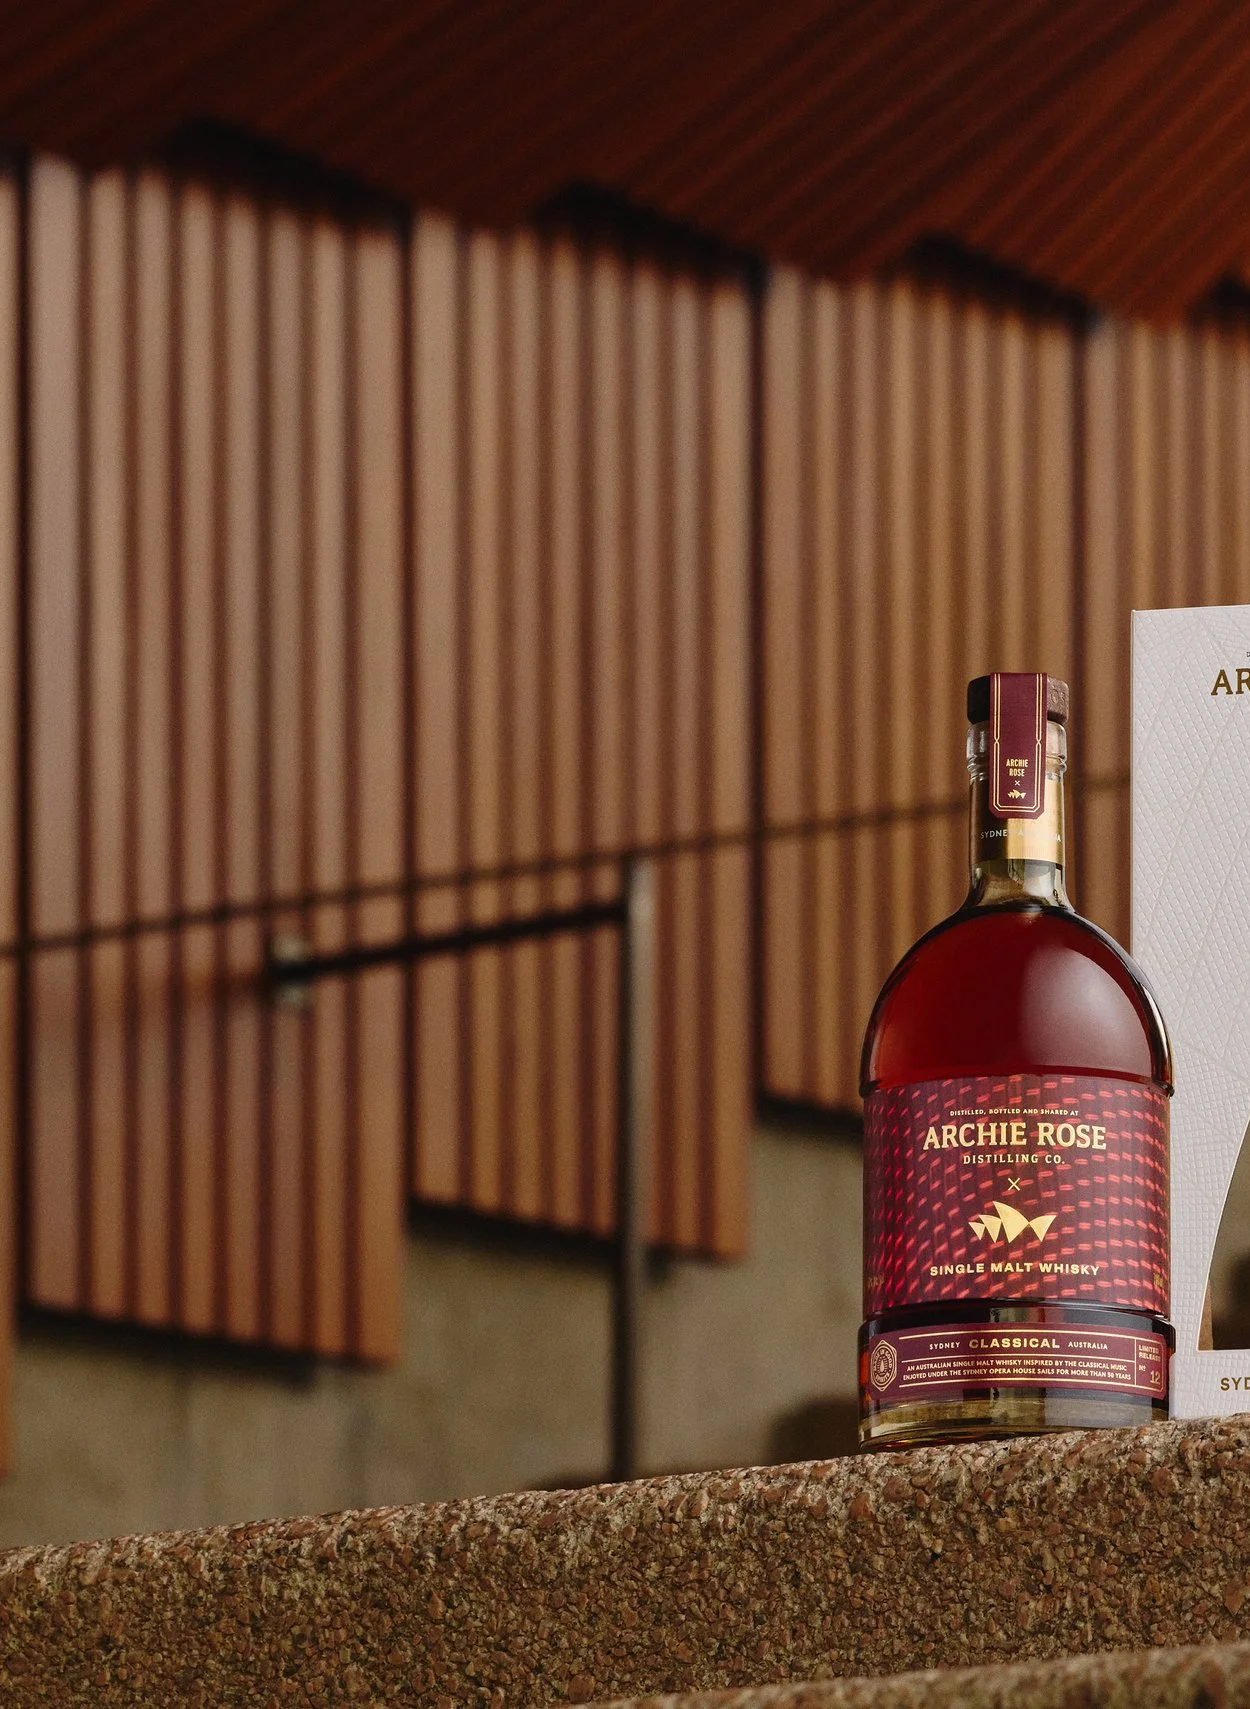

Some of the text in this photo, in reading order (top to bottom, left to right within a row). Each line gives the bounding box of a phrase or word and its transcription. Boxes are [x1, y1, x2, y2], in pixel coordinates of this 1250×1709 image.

[1006, 758, 1029, 768] ARCHIE
[1008, 768, 1026, 777] ROSE
[980, 829, 1008, 839] SYDNE
[1040, 1108, 1068, 1116] SHARED
[922, 1122, 1107, 1150] ARCHIE ROSE
[963, 1154, 1066, 1164] DISTILLING CO.
[930, 1263, 1100, 1276] SINGLE MALT WHISKY
[929, 1337, 1109, 1350] SYDNEY CLASSICAL AUSTRALIA
[915, 1361, 952, 1371] AUSTRALIAN
[1078, 1361, 1110, 1370] CLASSICAL
[927, 1371, 949, 1379] UNDER
[1070, 1369, 1088, 1377] MORE
[1089, 1370, 1107, 1378] THAN
[1150, 1370, 1161, 1385] 12
